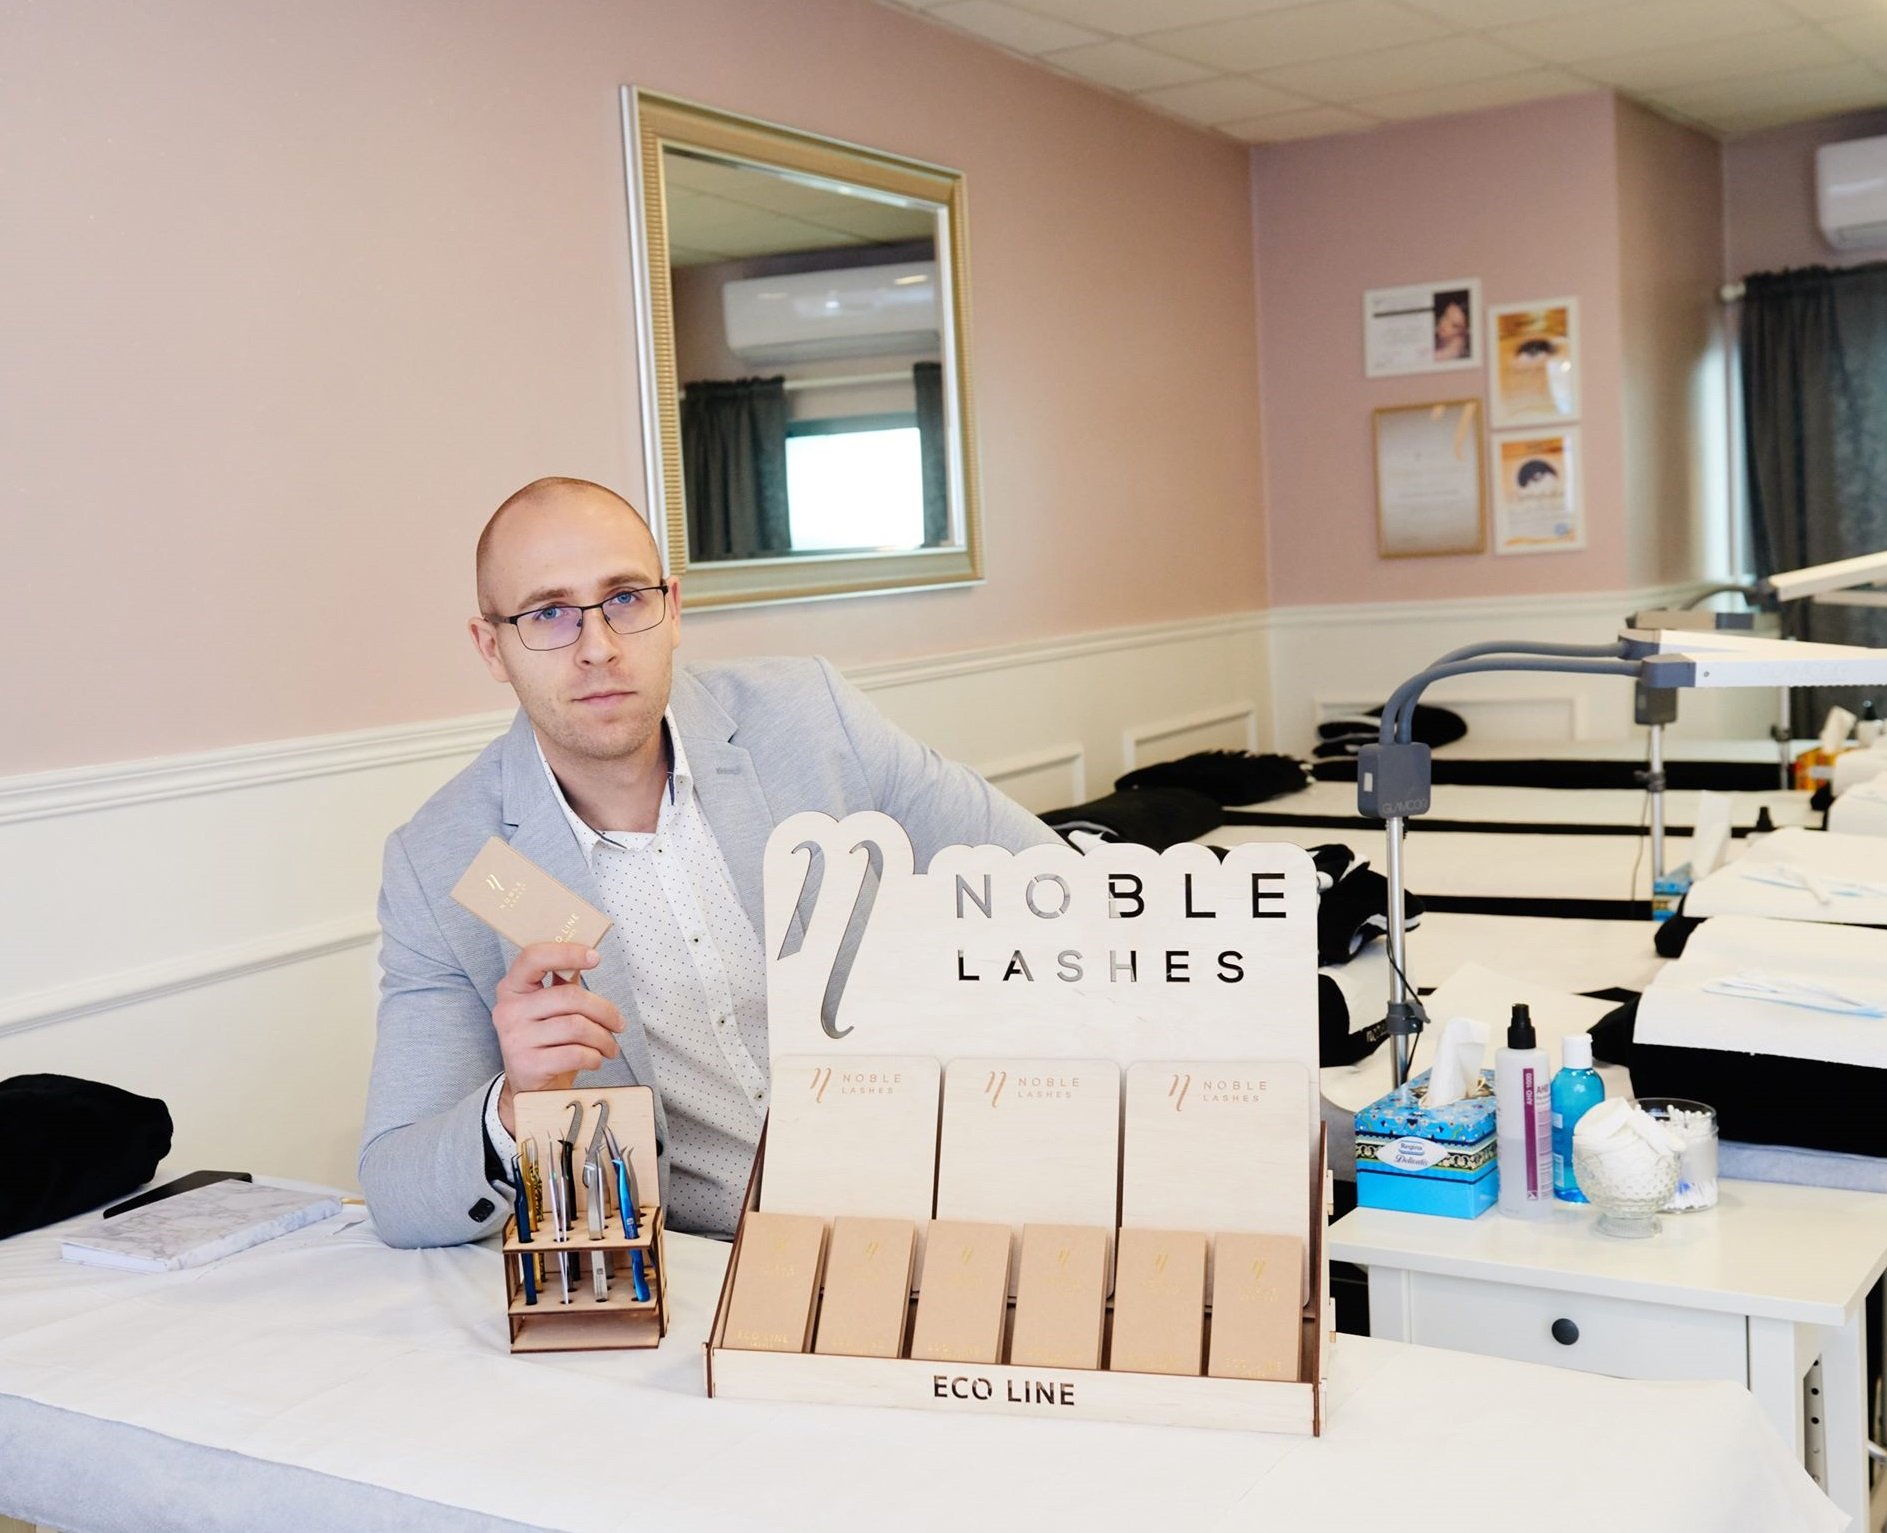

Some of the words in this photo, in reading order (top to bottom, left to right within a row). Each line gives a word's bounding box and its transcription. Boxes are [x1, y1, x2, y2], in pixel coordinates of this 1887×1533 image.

[956, 872, 1287, 919] NOBLE
[957, 950, 1245, 983] LASHES
[842, 1073, 902, 1084] NOBLE
[1018, 1077, 1080, 1087] NOBLE
[1203, 1081, 1268, 1091] NOBLE
[934, 1375, 993, 1400] ECO
[1007, 1380, 1075, 1406] LINE
